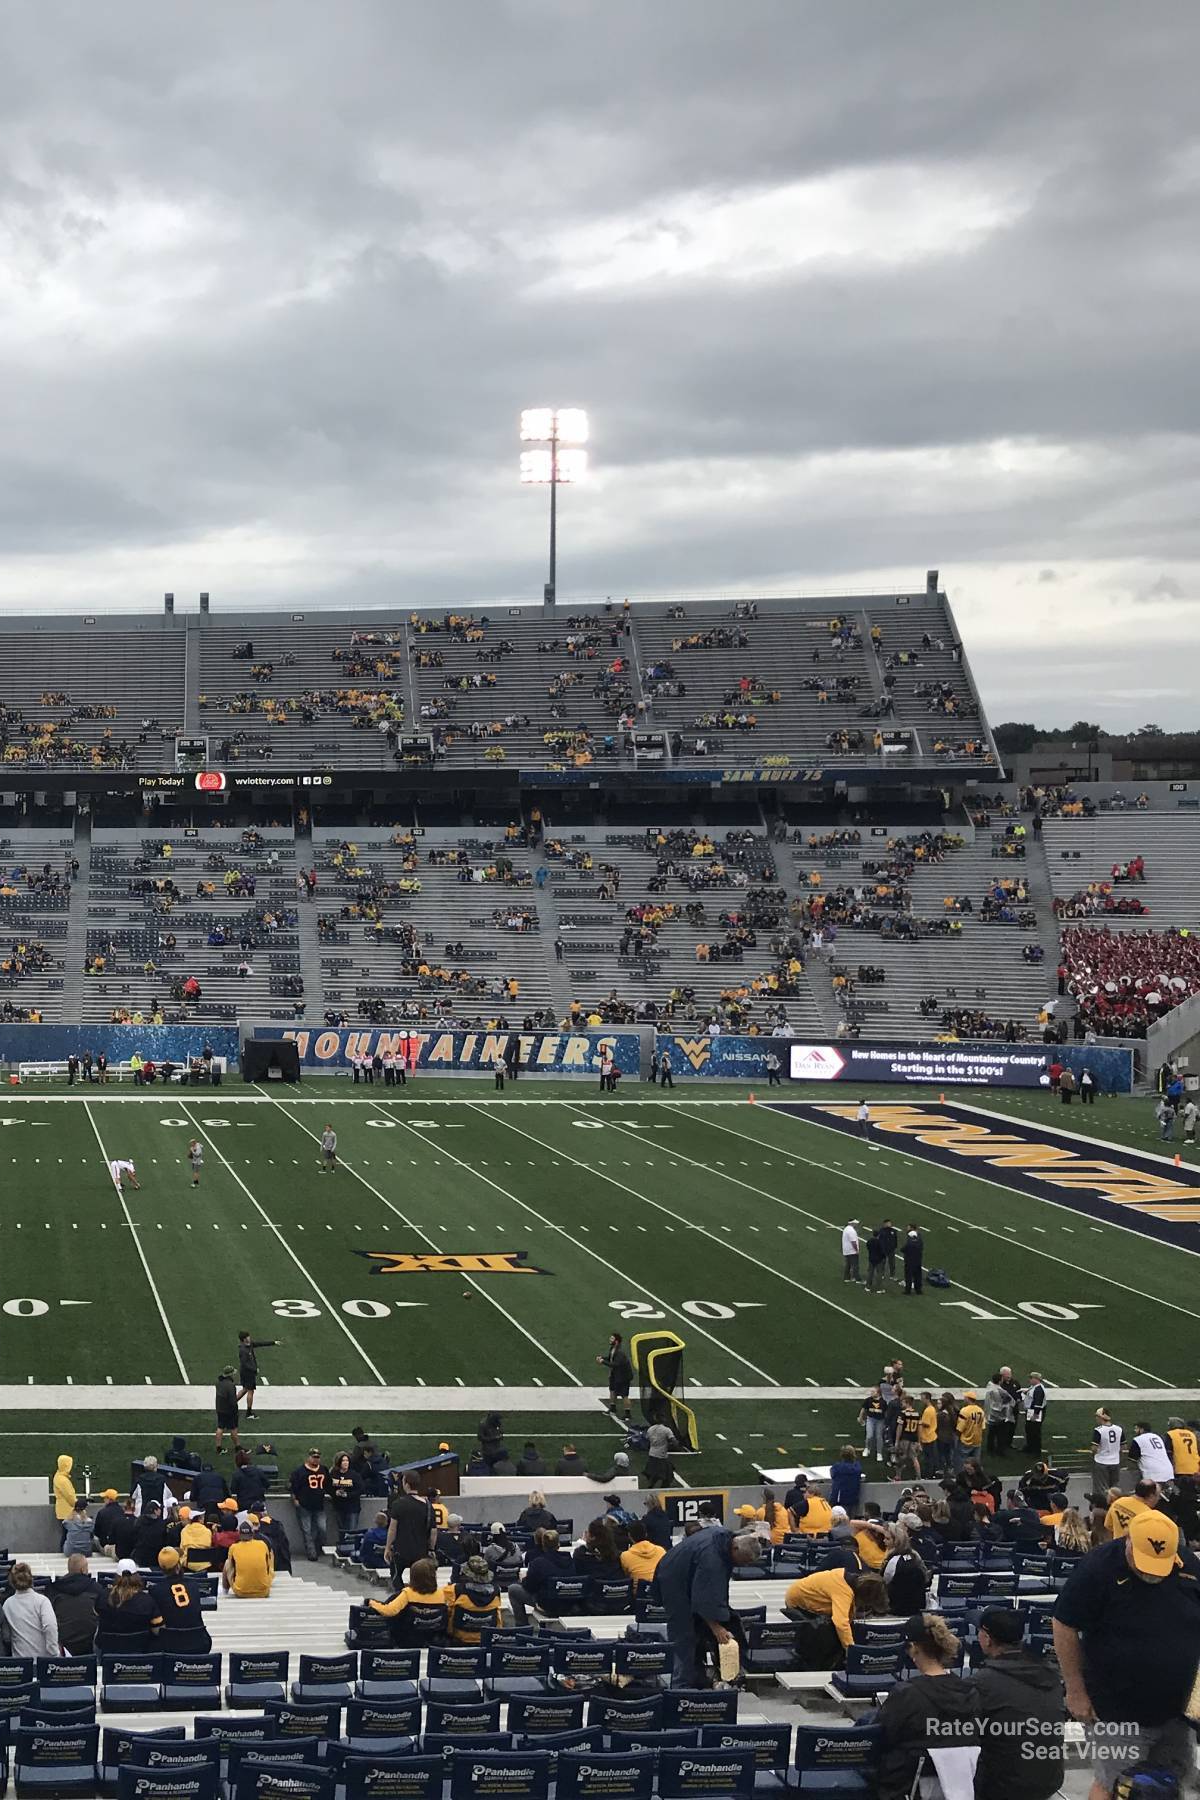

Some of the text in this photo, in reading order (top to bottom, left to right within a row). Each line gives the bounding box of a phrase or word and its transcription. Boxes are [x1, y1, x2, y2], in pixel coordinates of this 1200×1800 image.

[721, 771, 755, 782] SAM
[759, 770, 798, 782] HUFF
[138, 777, 294, 787] Play Today! wvlottery.com
[722, 1052, 771, 1062] NISSAN
[852, 1051, 1046, 1066] New Homes in the Heart of Mountaineer Country!
[891, 1064, 1003, 1076] Starting in the $100's!
[810, 1105, 1200, 1223] MOUNTAI
[272, 1299, 392, 1318] 30
[608, 1300, 736, 1319] 20
[940, 1301, 1081, 1320] 10
[971, 1411, 984, 1426] 47
[904, 1419, 919, 1433] 10
[1108, 1430, 1117, 1444] 8
[1149, 1437, 1163, 1450] 16
[1182, 1438, 1194, 1454] 7
[308, 1474, 325, 1489] 67
[171, 1583, 190, 1608] 8
[55, 1665, 87, 1673] Panhandle
[689, 1701, 728, 1709] Panhandle
[373, 1711, 412, 1720] Panhandle
[535, 1707, 573, 1715] Panhandle
[616, 1710, 654, 1719] Panhandle
[452, 1714, 491, 1723] Panhandle
[222, 1729, 265, 1738] Panhandle
[44, 1738, 87, 1747] Panhandle
[733, 1739, 778, 1747] Panhandle
[827, 1740, 873, 1748] Panhandle
[161, 1754, 208, 1763] Panhandle
[258, 1752, 305, 1761] Panhandle
[486, 1767, 536, 1776] Panhandle
[591, 1768, 640, 1776] Panhandle
[693, 1764, 743, 1772] Panhandle
[379, 1771, 430, 1780] Panhandle
[149, 1781, 200, 1791] Panhandle
